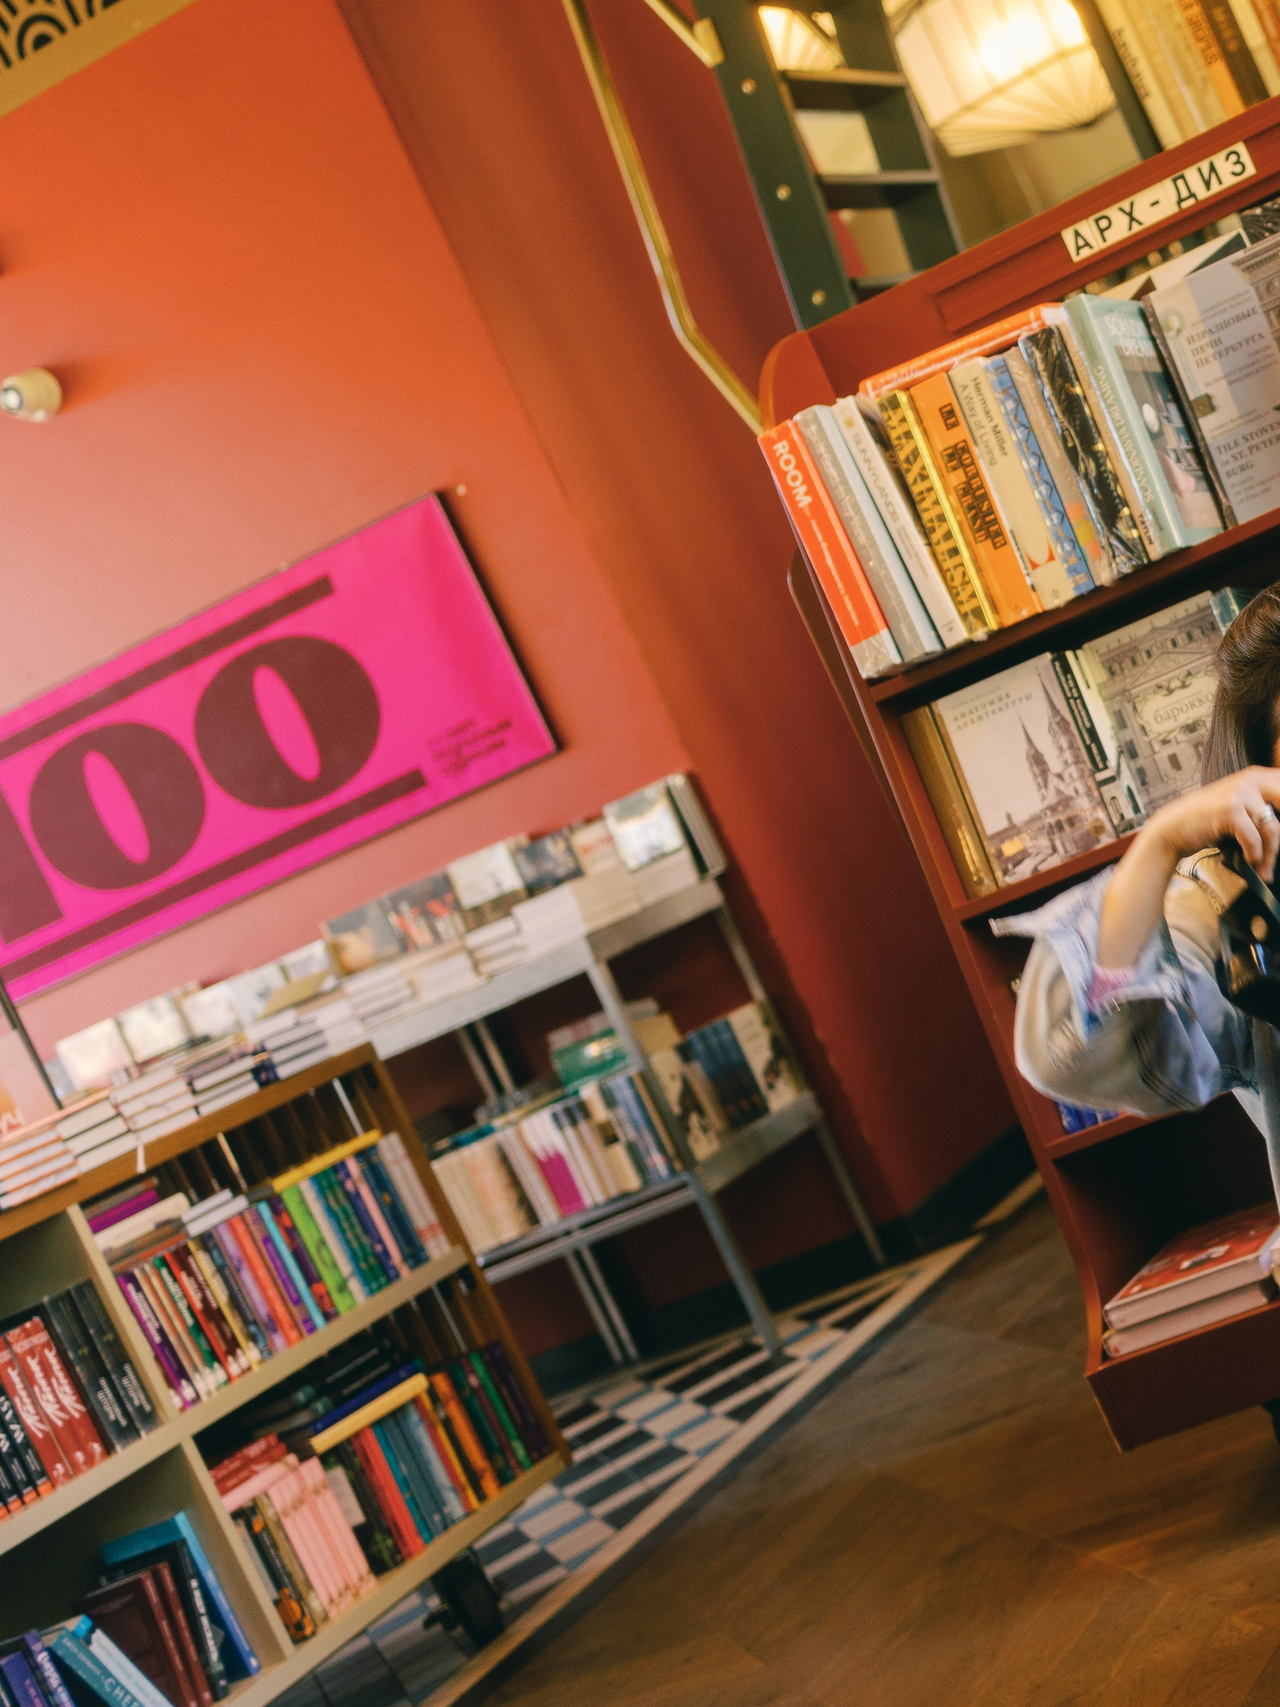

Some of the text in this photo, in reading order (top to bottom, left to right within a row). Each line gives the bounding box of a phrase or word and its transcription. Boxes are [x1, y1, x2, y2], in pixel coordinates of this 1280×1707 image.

[1185, 305, 1259, 345] ИЗРАЗЦОВЫЕ
[1190, 336, 1223, 356] ПЕЧИ
[1194, 330, 1265, 368] ПЕТЕРБУРГА
[957, 382, 999, 466] A Way of Living
[969, 376, 1010, 458] Herman Miller
[1092, 364, 1125, 427] DREAMING
[772, 439, 812, 508] ROOM
[850, 431, 900, 523] SUNNYLANDS
[937, 402, 1008, 550] LE CORBUSIER
[1116, 425, 1155, 503] SCANDINAVIA
[1214, 437, 1240, 456] TILE
[1224, 459, 1254, 478] BURG
[880, 405, 981, 614] MAXIMALISM
[938, 445, 989, 545] LE GRAND
[952, 690, 1011, 722] АНАТОМИЯ
[955, 692, 1033, 731] АРХИТЕКТУРЫ
[1152, 689, 1215, 727] барокко
